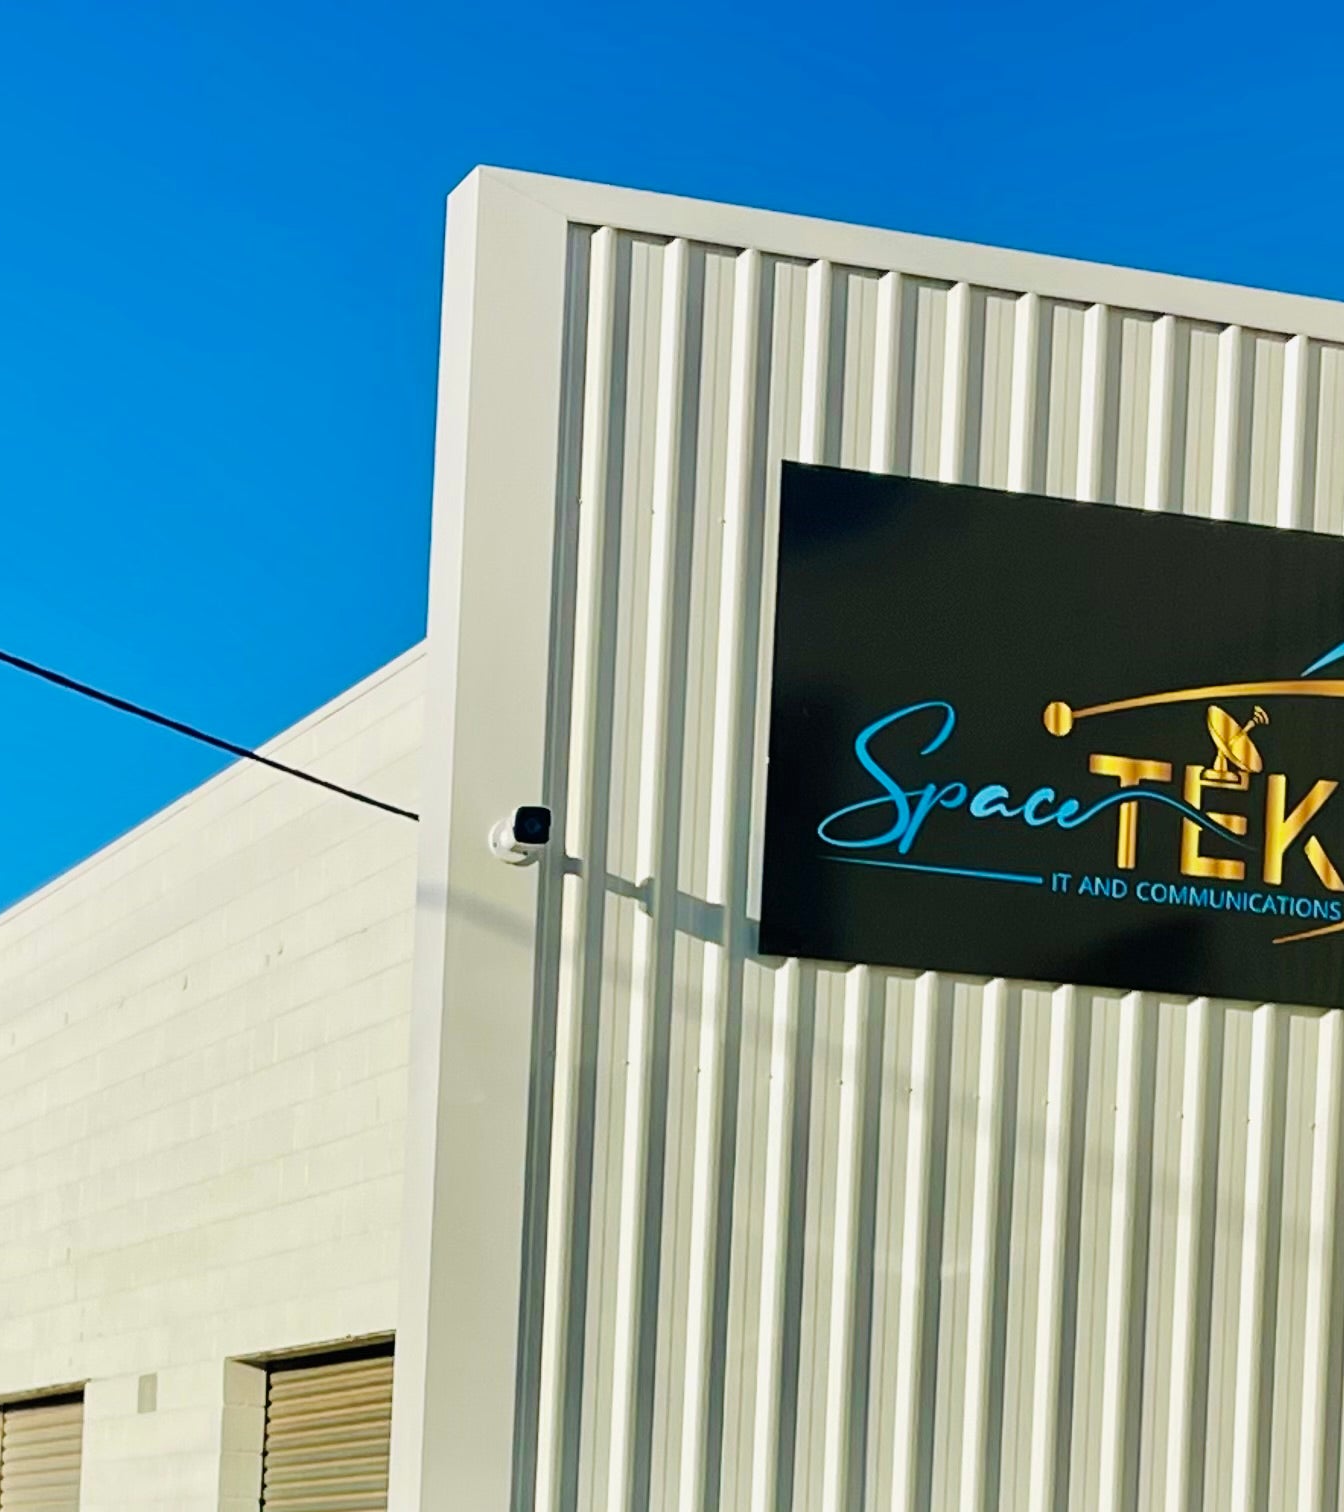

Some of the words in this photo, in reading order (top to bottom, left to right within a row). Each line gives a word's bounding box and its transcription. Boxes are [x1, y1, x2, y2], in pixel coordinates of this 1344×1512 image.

[817, 700, 1090, 854] Space
[1051, 872, 1072, 893] IT
[1077, 875, 1128, 899] AND
[1135, 881, 1344, 921] COMMUNICATIONS
